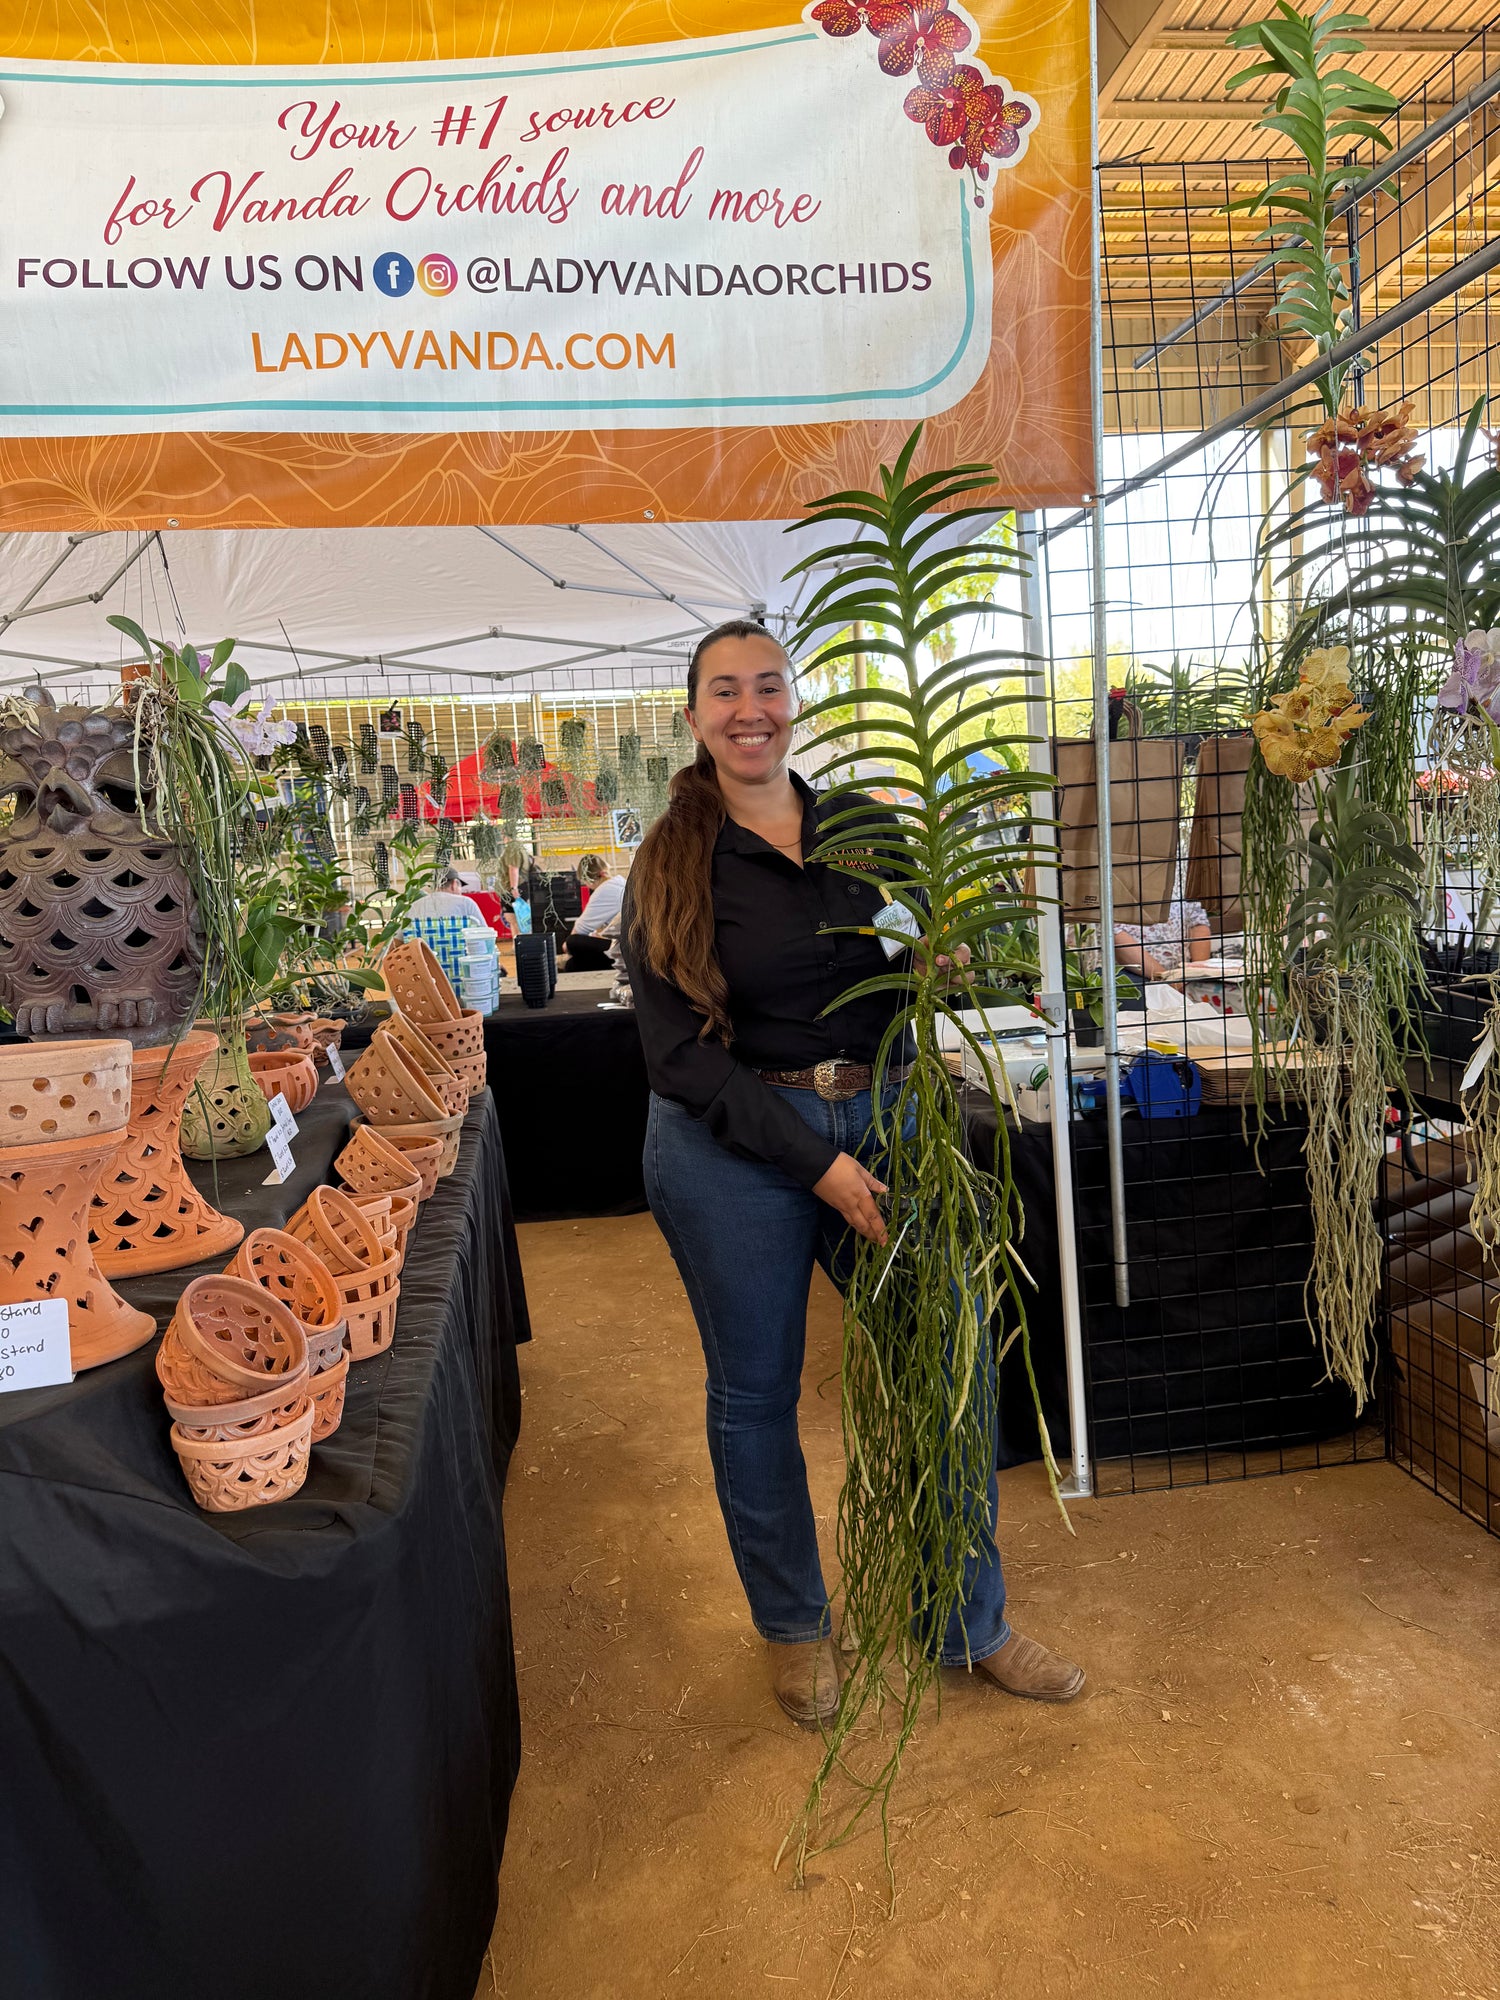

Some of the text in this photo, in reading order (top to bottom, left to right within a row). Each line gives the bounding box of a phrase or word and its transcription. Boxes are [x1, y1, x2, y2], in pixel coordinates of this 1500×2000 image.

[277, 95, 676, 161] Your #1 source
[103, 145, 821, 246] for Vanda Orchids and more
[17, 255, 212, 290] FOLLOW
[225, 254, 282, 291] US
[294, 254, 364, 292] ON
[466, 256, 932, 297] @LADYVANDAORCHIDS
[251, 329, 677, 373] LADYVANDA.COM
[1, 1302, 41, 1321] Stand
